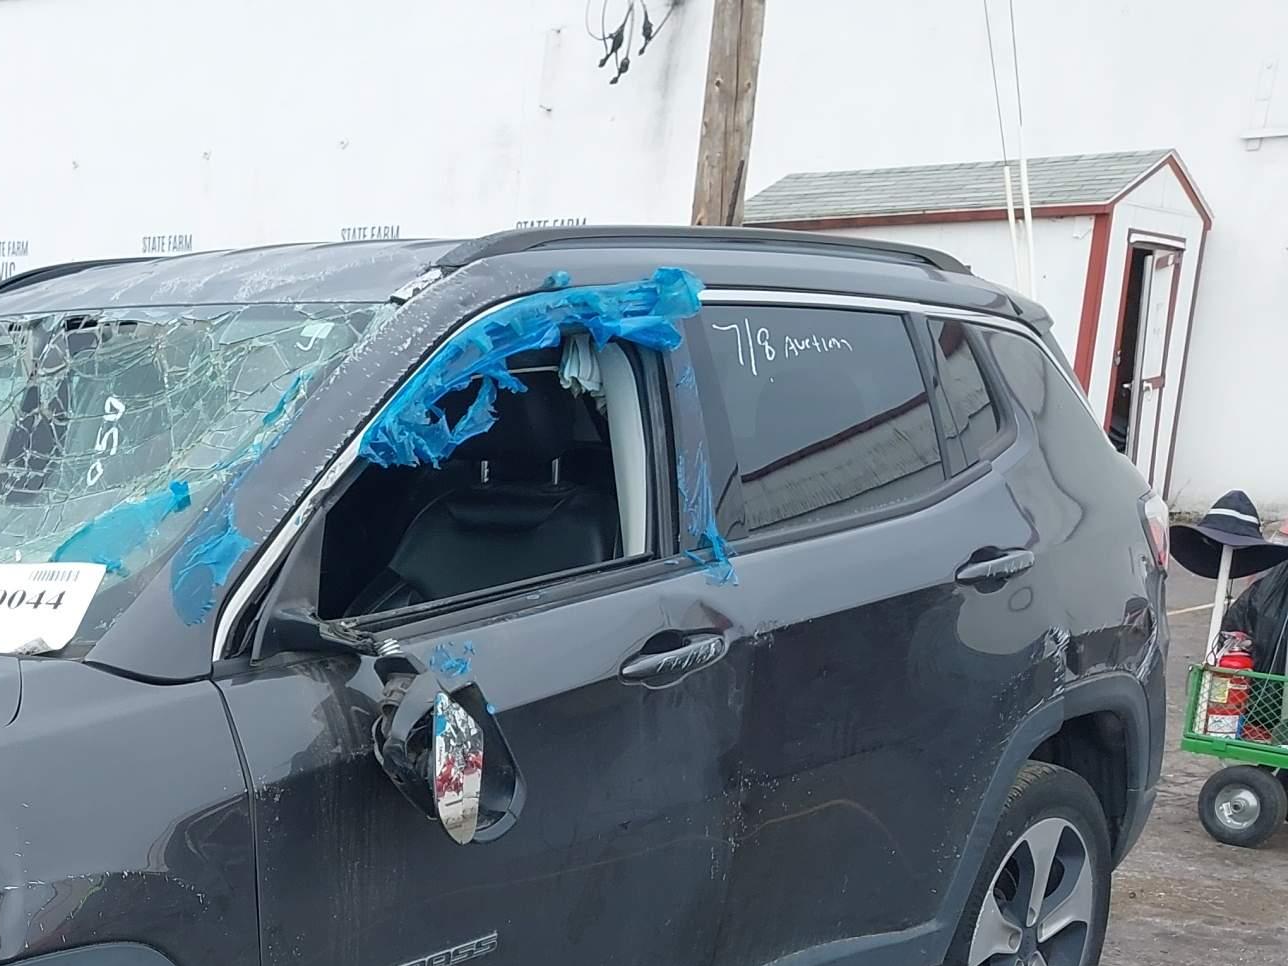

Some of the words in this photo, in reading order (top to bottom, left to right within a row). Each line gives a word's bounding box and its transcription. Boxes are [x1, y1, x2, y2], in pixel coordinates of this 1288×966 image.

[7, 240, 29, 257] FARM
[141, 236, 165, 253] STATE
[167, 234, 193, 251] FARM
[712, 317, 776, 376] 7/8
